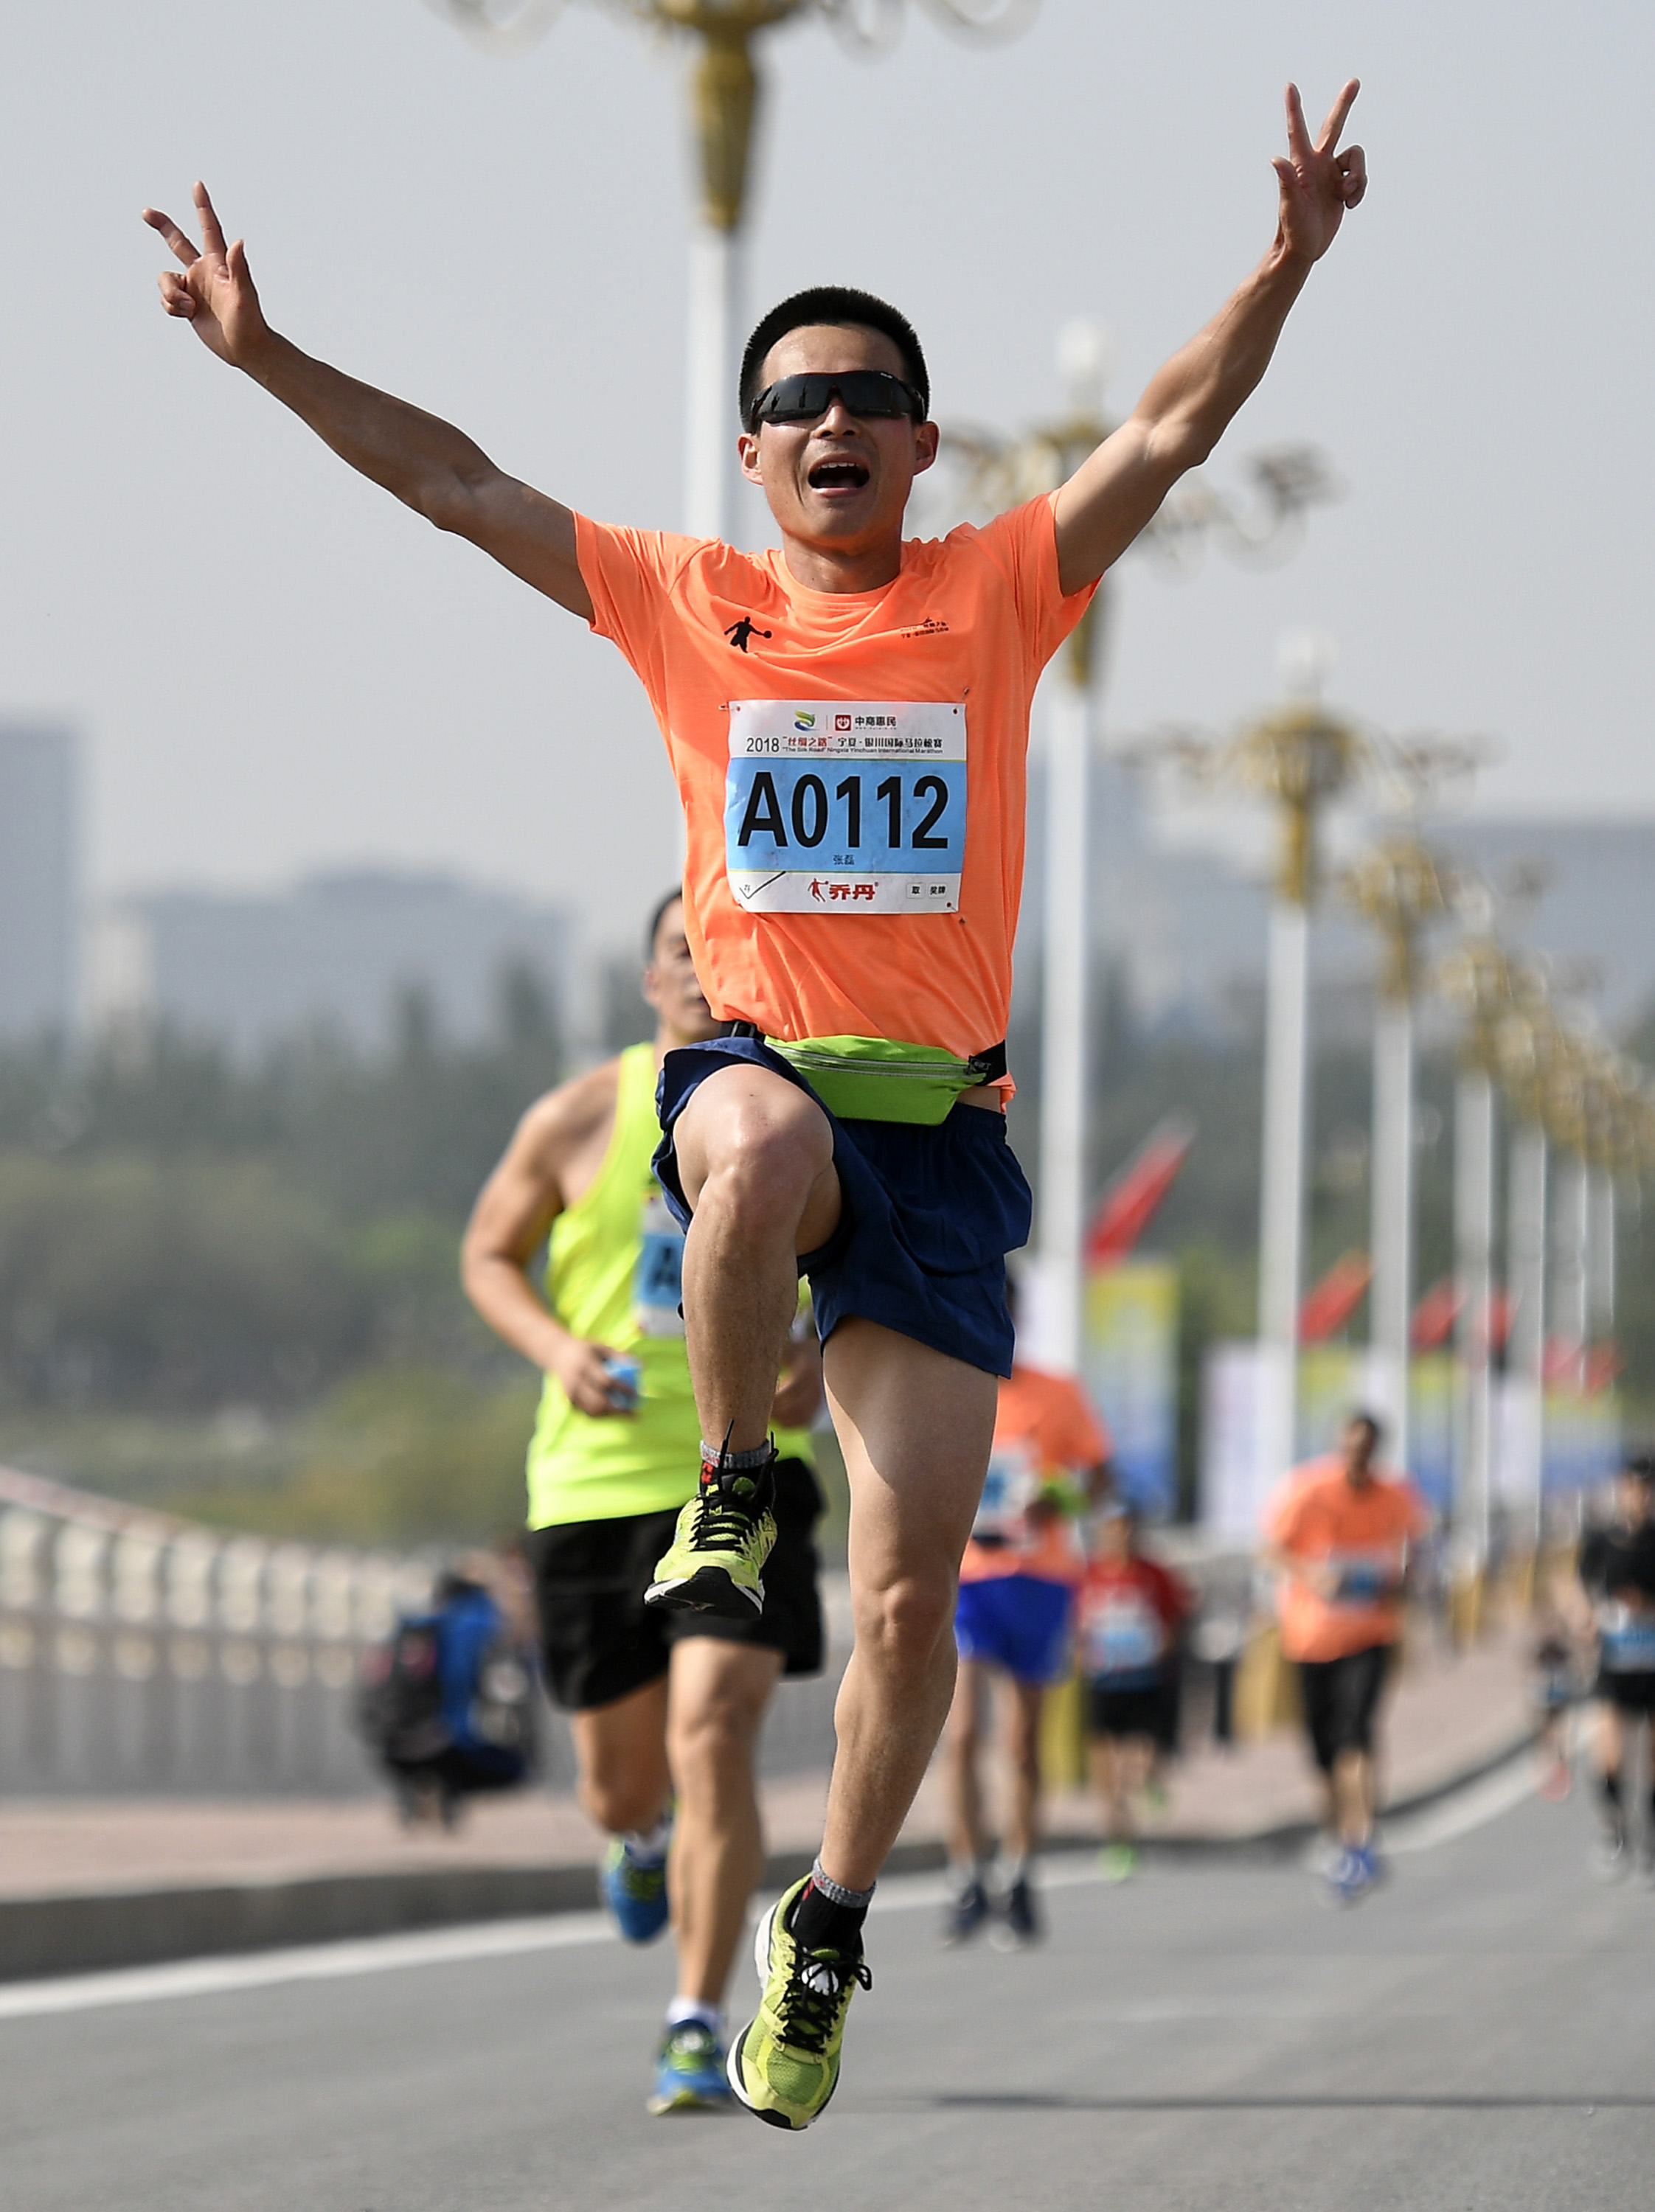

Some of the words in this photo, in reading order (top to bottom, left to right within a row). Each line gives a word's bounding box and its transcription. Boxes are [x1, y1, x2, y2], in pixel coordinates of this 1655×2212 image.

[855, 716, 897, 726] 中商惠民
[746, 737, 780, 753] 2018
[738, 771, 948, 849] A0112
[833, 854, 855, 866] 张磊
[829, 884, 875, 900] 乔丹
